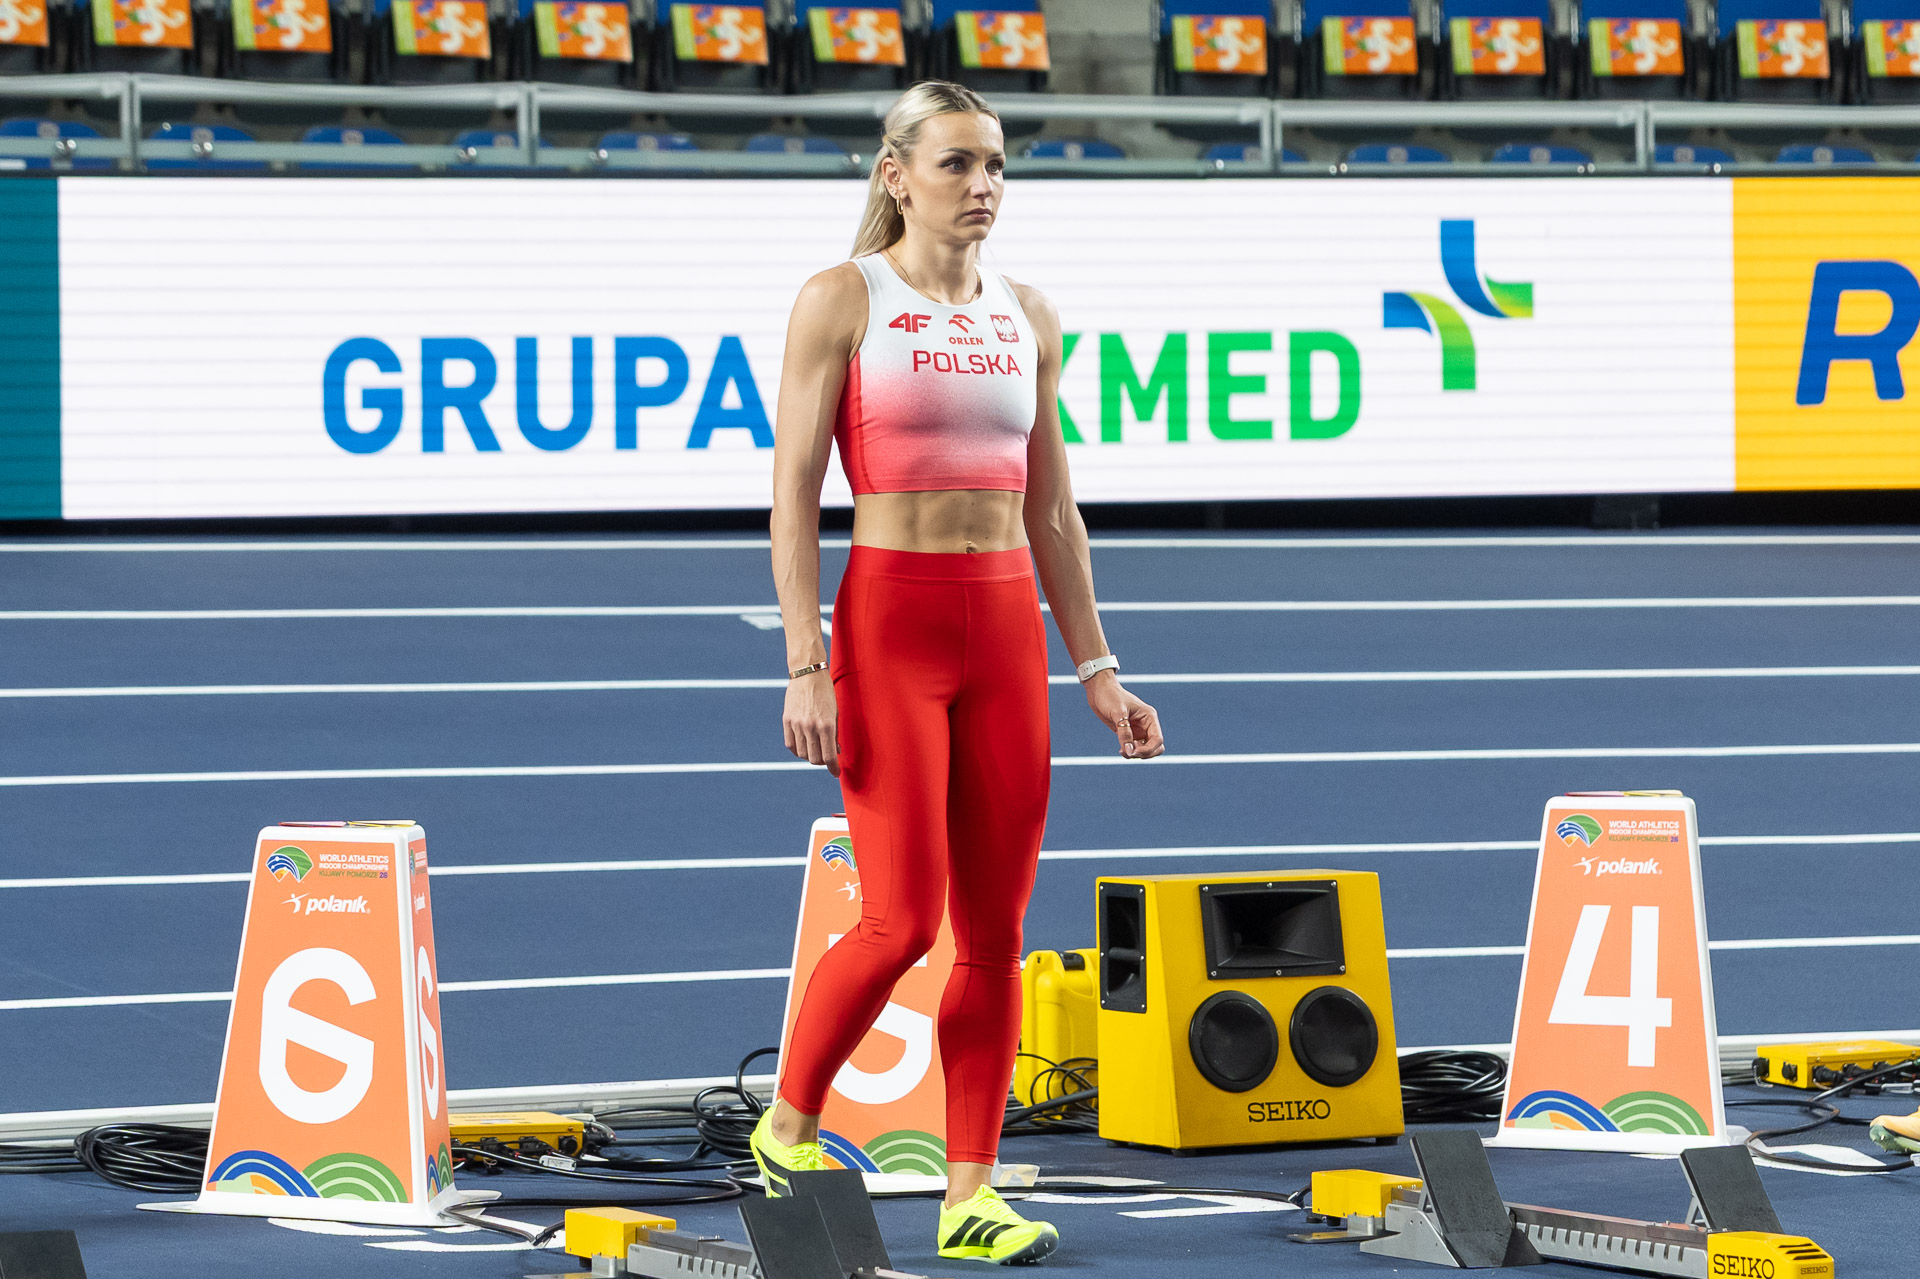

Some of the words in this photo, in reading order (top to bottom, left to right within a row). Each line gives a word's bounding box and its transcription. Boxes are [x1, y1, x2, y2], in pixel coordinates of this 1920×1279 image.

[888, 312, 932, 333] 4F
[1795, 260, 1920, 406] R
[949, 336, 984, 345] ORLEN
[913, 350, 1022, 376] POLSKA
[322, 334, 775, 454] GRUPA
[1608, 820, 1637, 829] WORLD
[1638, 821, 1680, 829] ATHLETICS
[319, 854, 347, 862] WORLD
[348, 855, 389, 864] ATHLETICS
[1548, 904, 1672, 1067] 4
[259, 947, 377, 1124] 6
[417, 945, 439, 1121] 6
[1247, 1098, 1331, 1122] SEIKO
[1713, 1253, 1775, 1279] SEIKO
[1800, 1266, 1828, 1275] SEIKO
